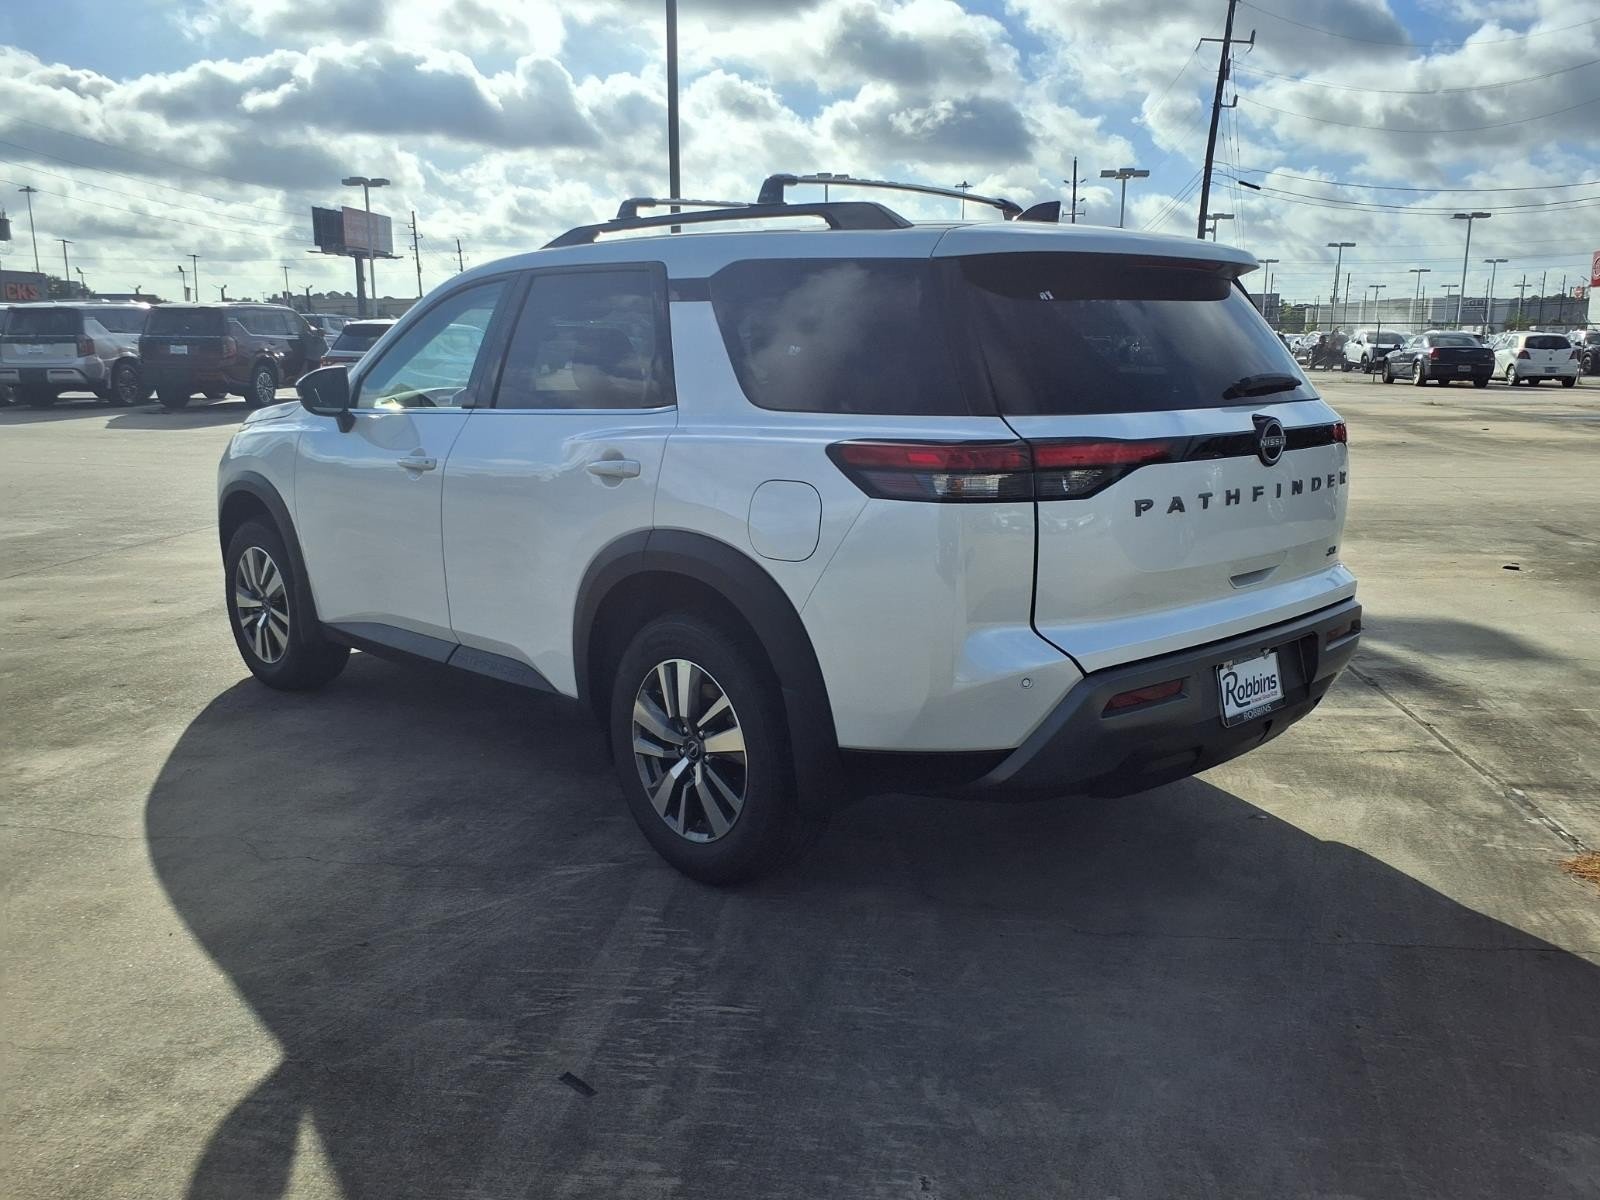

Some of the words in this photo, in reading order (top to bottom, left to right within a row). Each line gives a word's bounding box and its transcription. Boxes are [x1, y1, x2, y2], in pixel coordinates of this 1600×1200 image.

[1134, 471, 1347, 517] PATHFINDER
[1222, 671, 1277, 708] Robbins
[1243, 704, 1272, 720] ROBBINS
